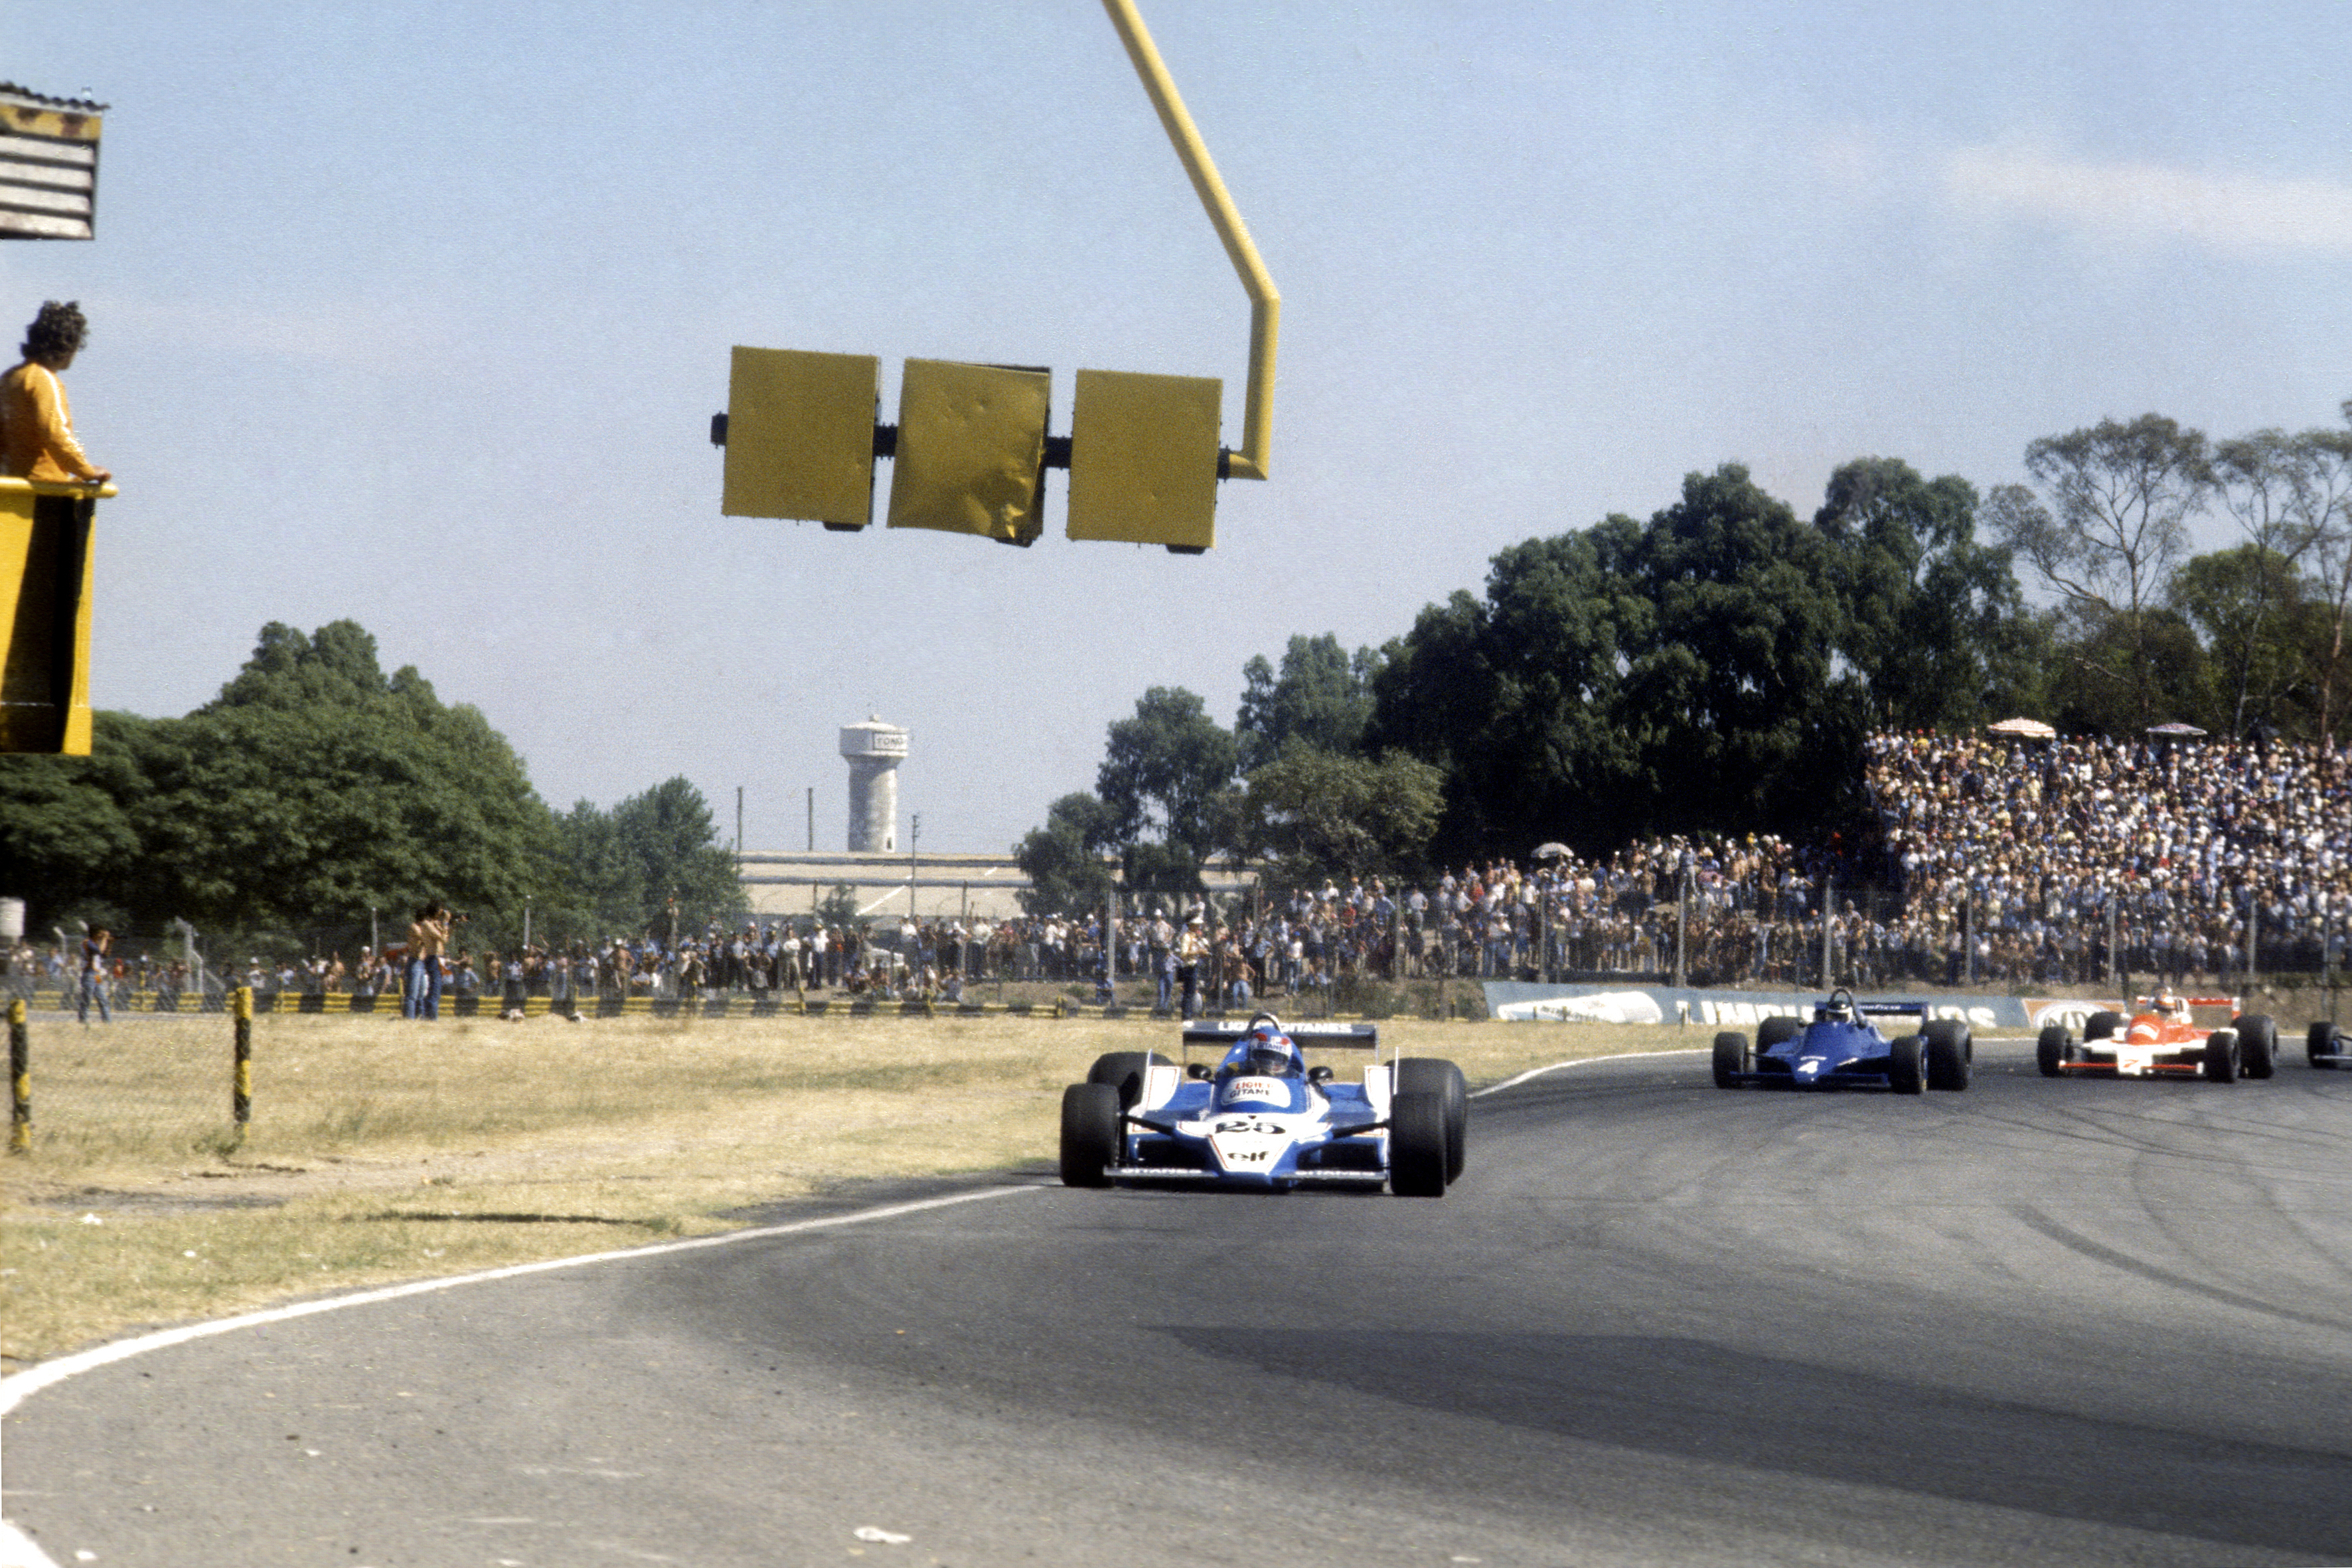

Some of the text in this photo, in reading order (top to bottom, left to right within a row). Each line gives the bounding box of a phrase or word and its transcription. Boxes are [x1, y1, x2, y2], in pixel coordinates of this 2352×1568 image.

[1797, 1060, 1818, 1073] 4
[2123, 1059, 2140, 1069] 7
[1229, 1088, 1271, 1098] GITANE
[1215, 1121, 1287, 1135] 25
[1227, 1151, 1269, 1162] elf
